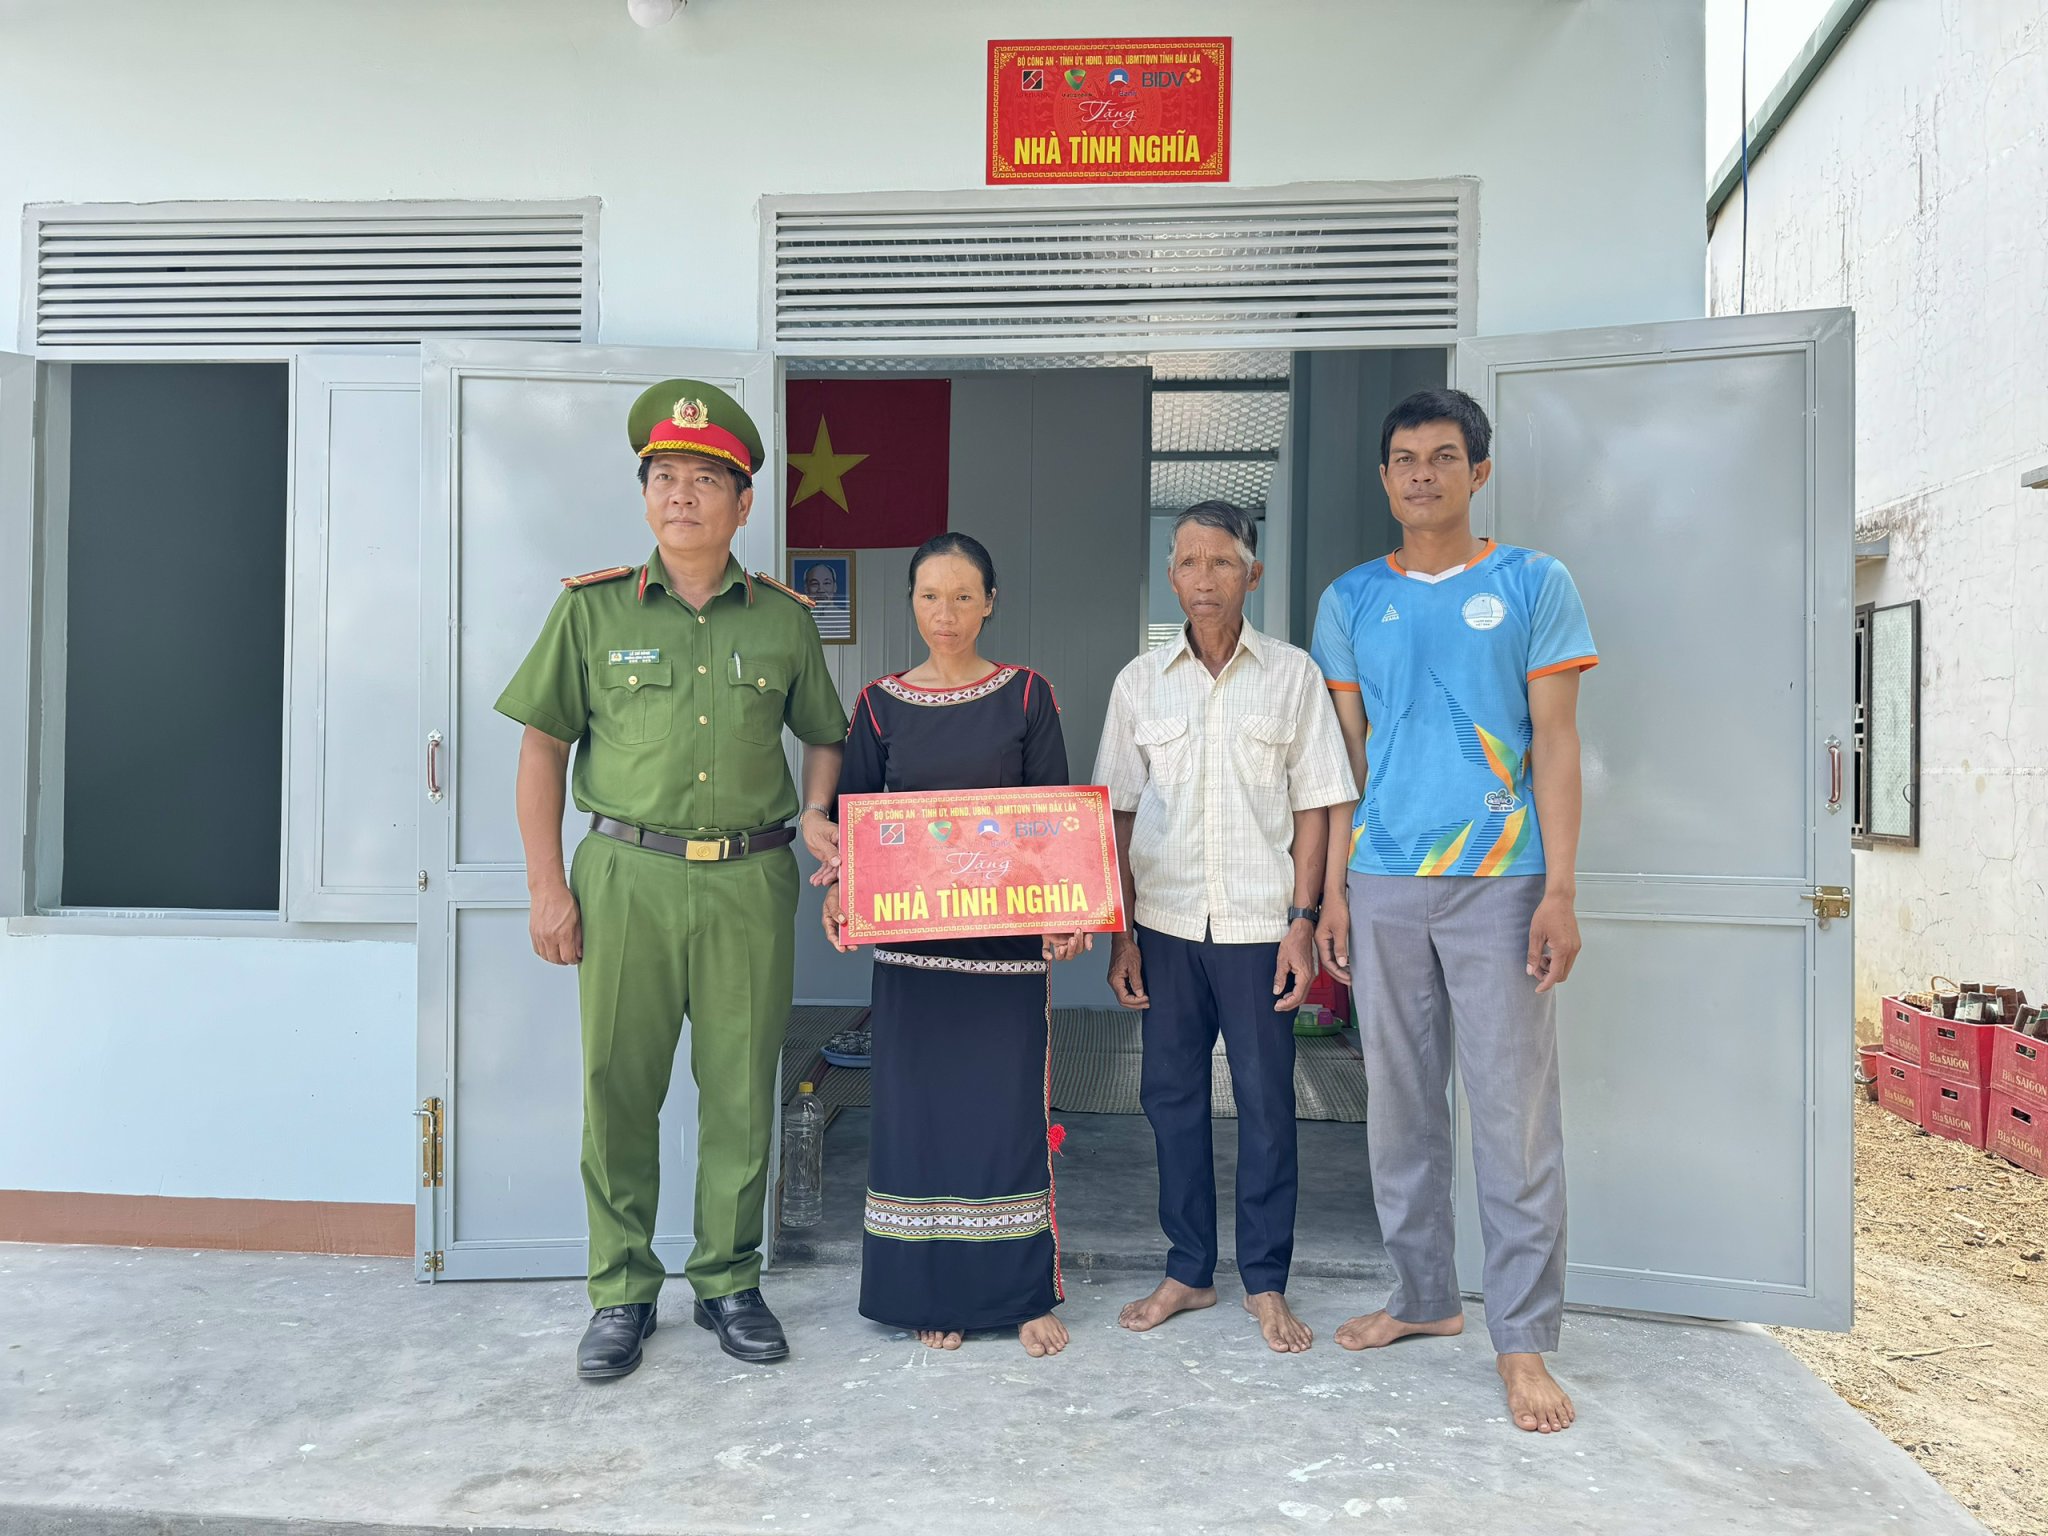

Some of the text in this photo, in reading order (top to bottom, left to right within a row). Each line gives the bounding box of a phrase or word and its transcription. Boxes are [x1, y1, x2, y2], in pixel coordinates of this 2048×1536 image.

[1027, 54, 1044, 66] CÔNG
[1045, 56, 1054, 66] AN
[1105, 54, 1124, 65] UBND,
[1125, 54, 1158, 65] UBMTTQVN
[1141, 71, 1187, 88] BIDV
[1079, 100, 1137, 129] Tặng
[1014, 129, 1201, 165] NHÀ TÌNH NGHĨA
[885, 808, 904, 820] CÔNG
[905, 809, 915, 819] AN
[972, 806, 993, 817] UBND,
[1015, 820, 1063, 838] BIDV
[946, 851, 1013, 880] Tặng
[873, 878, 1089, 923] NHÀ TÌNH NGHĨA
[1941, 1055, 1970, 1071] SAIGON
[2016, 1075, 2047, 1096] SAIGON
[1944, 1114, 1972, 1132] SAIGON
[2011, 1136, 2042, 1160] SAIGON
